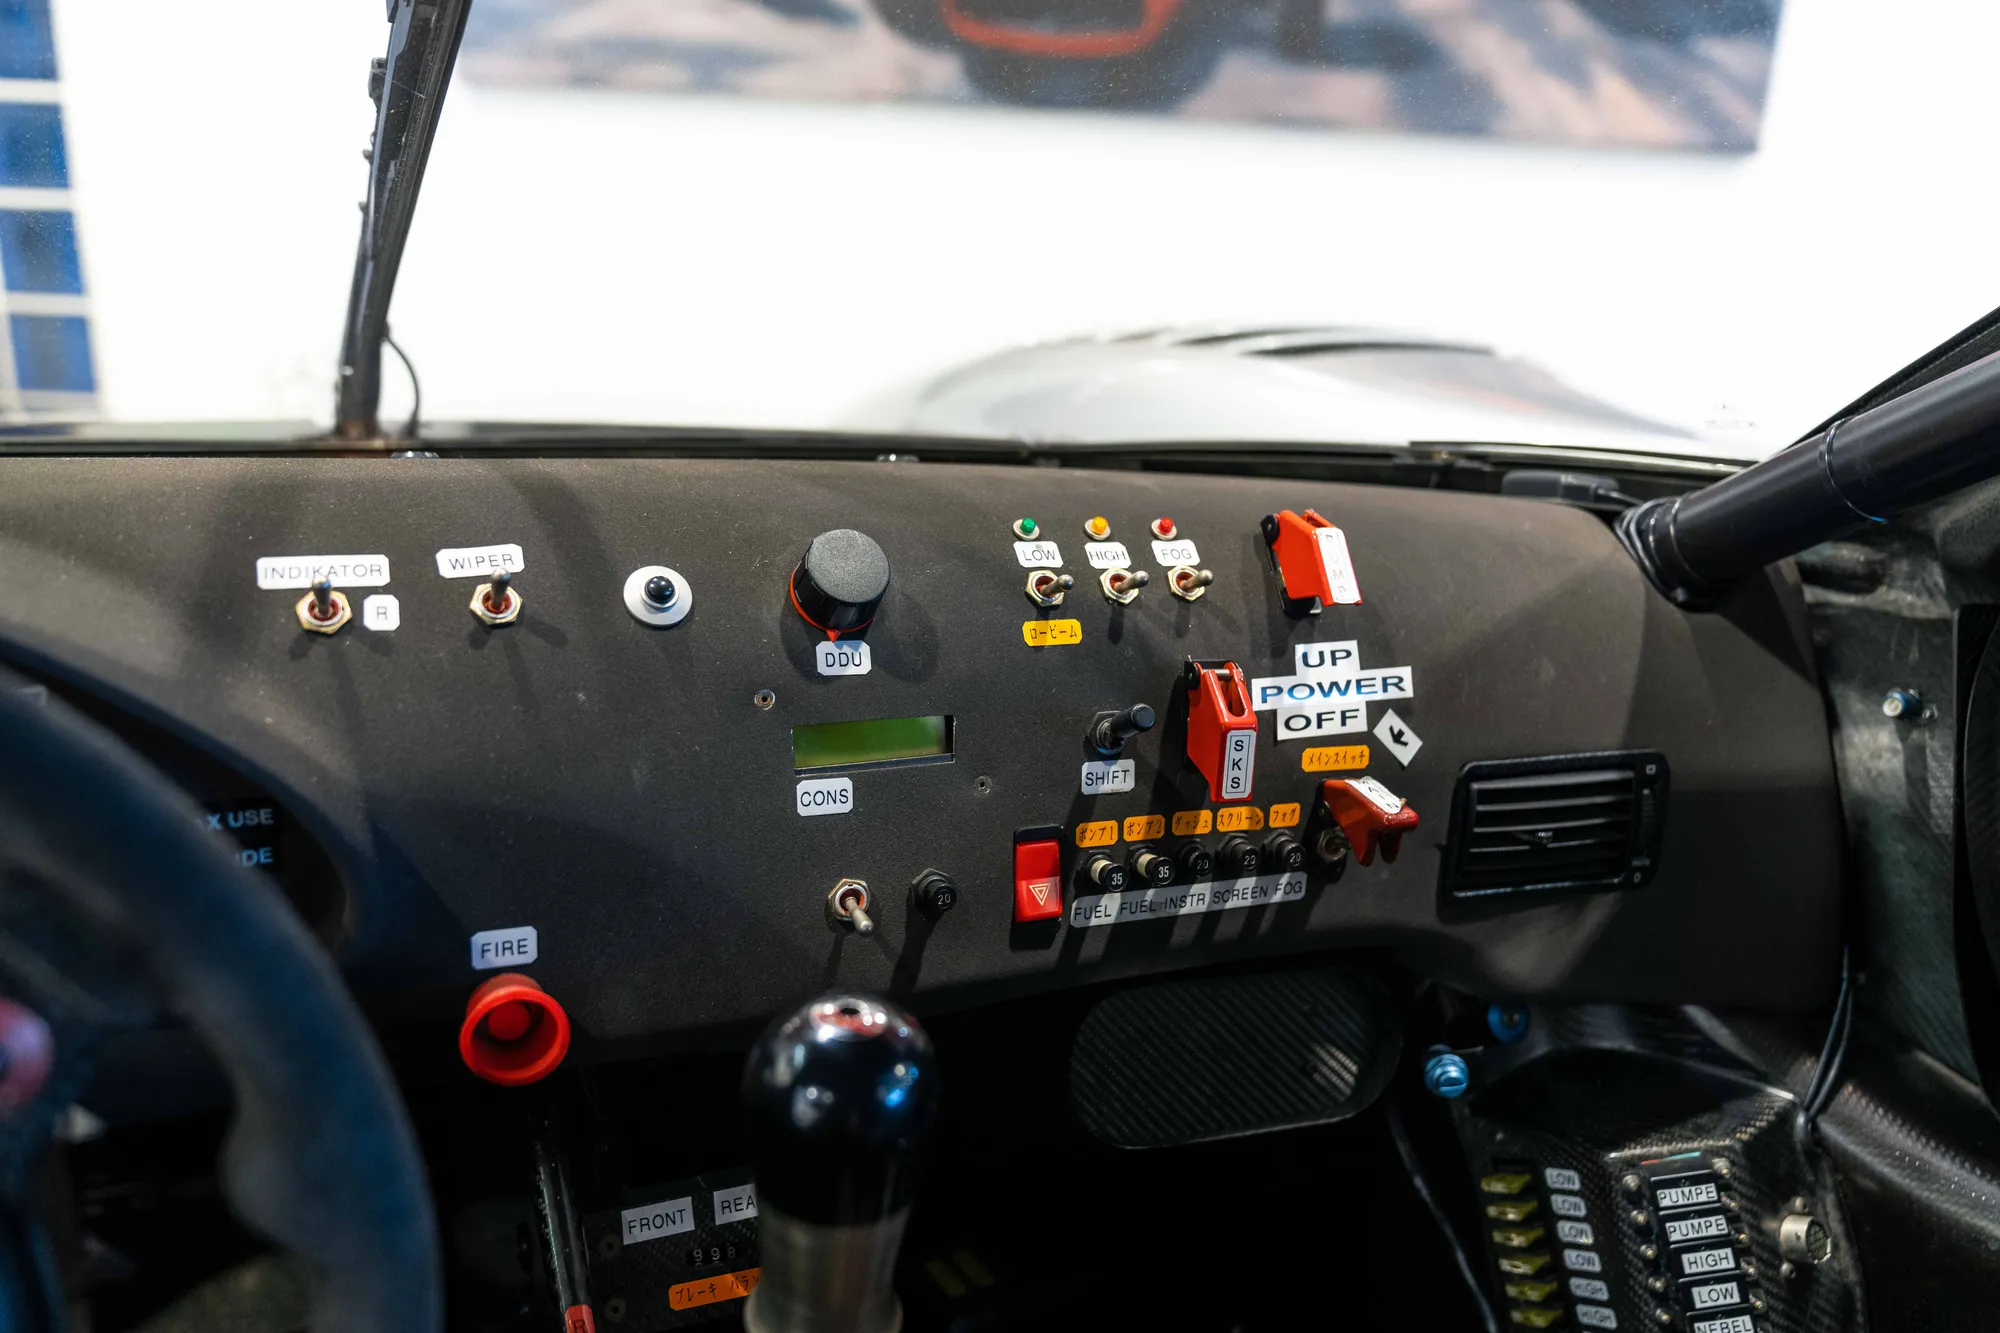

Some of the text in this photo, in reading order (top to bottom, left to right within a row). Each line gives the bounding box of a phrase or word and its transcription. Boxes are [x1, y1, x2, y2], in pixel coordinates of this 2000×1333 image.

[448, 553, 515, 570] WIPER
[1022, 548, 1057, 562] LOW
[1088, 549, 1126, 562] HIGH
[1161, 547, 1193, 561] FOG
[263, 563, 383, 580] INDIKATOR
[375, 605, 389, 621] R
[825, 651, 863, 668] DDU
[1301, 649, 1353, 669] UP
[1260, 675, 1407, 704] POWER
[1283, 708, 1360, 732] OFF
[1230, 739, 1245, 789] SKS
[1084, 769, 1131, 787] SHIFT
[800, 788, 850, 807] CONS
[227, 808, 275, 828] USE
[1196, 859, 1209, 869] 20
[1244, 855, 1256, 866] 20
[1289, 852, 1302, 864] 20
[1111, 872, 1123, 885] 35
[1157, 866, 1170, 878] 35
[937, 894, 951, 906] 20
[1073, 880, 1303, 921] FUEL FUEL INSTR SCREEN FOG
[481, 938, 529, 959] FIRE
[1550, 1172, 1576, 1183] LOW
[1658, 1185, 1716, 1204] PUMPE
[720, 1194, 757, 1216] REA
[1557, 1198, 1583, 1209] LOW
[627, 1208, 687, 1235] FRONT
[1667, 1220, 1726, 1239] PUMPE
[1562, 1225, 1590, 1239] LOW
[1569, 1252, 1597, 1267] LOW
[1687, 1252, 1730, 1270] HIGH
[1697, 1286, 1735, 1304] LOW
